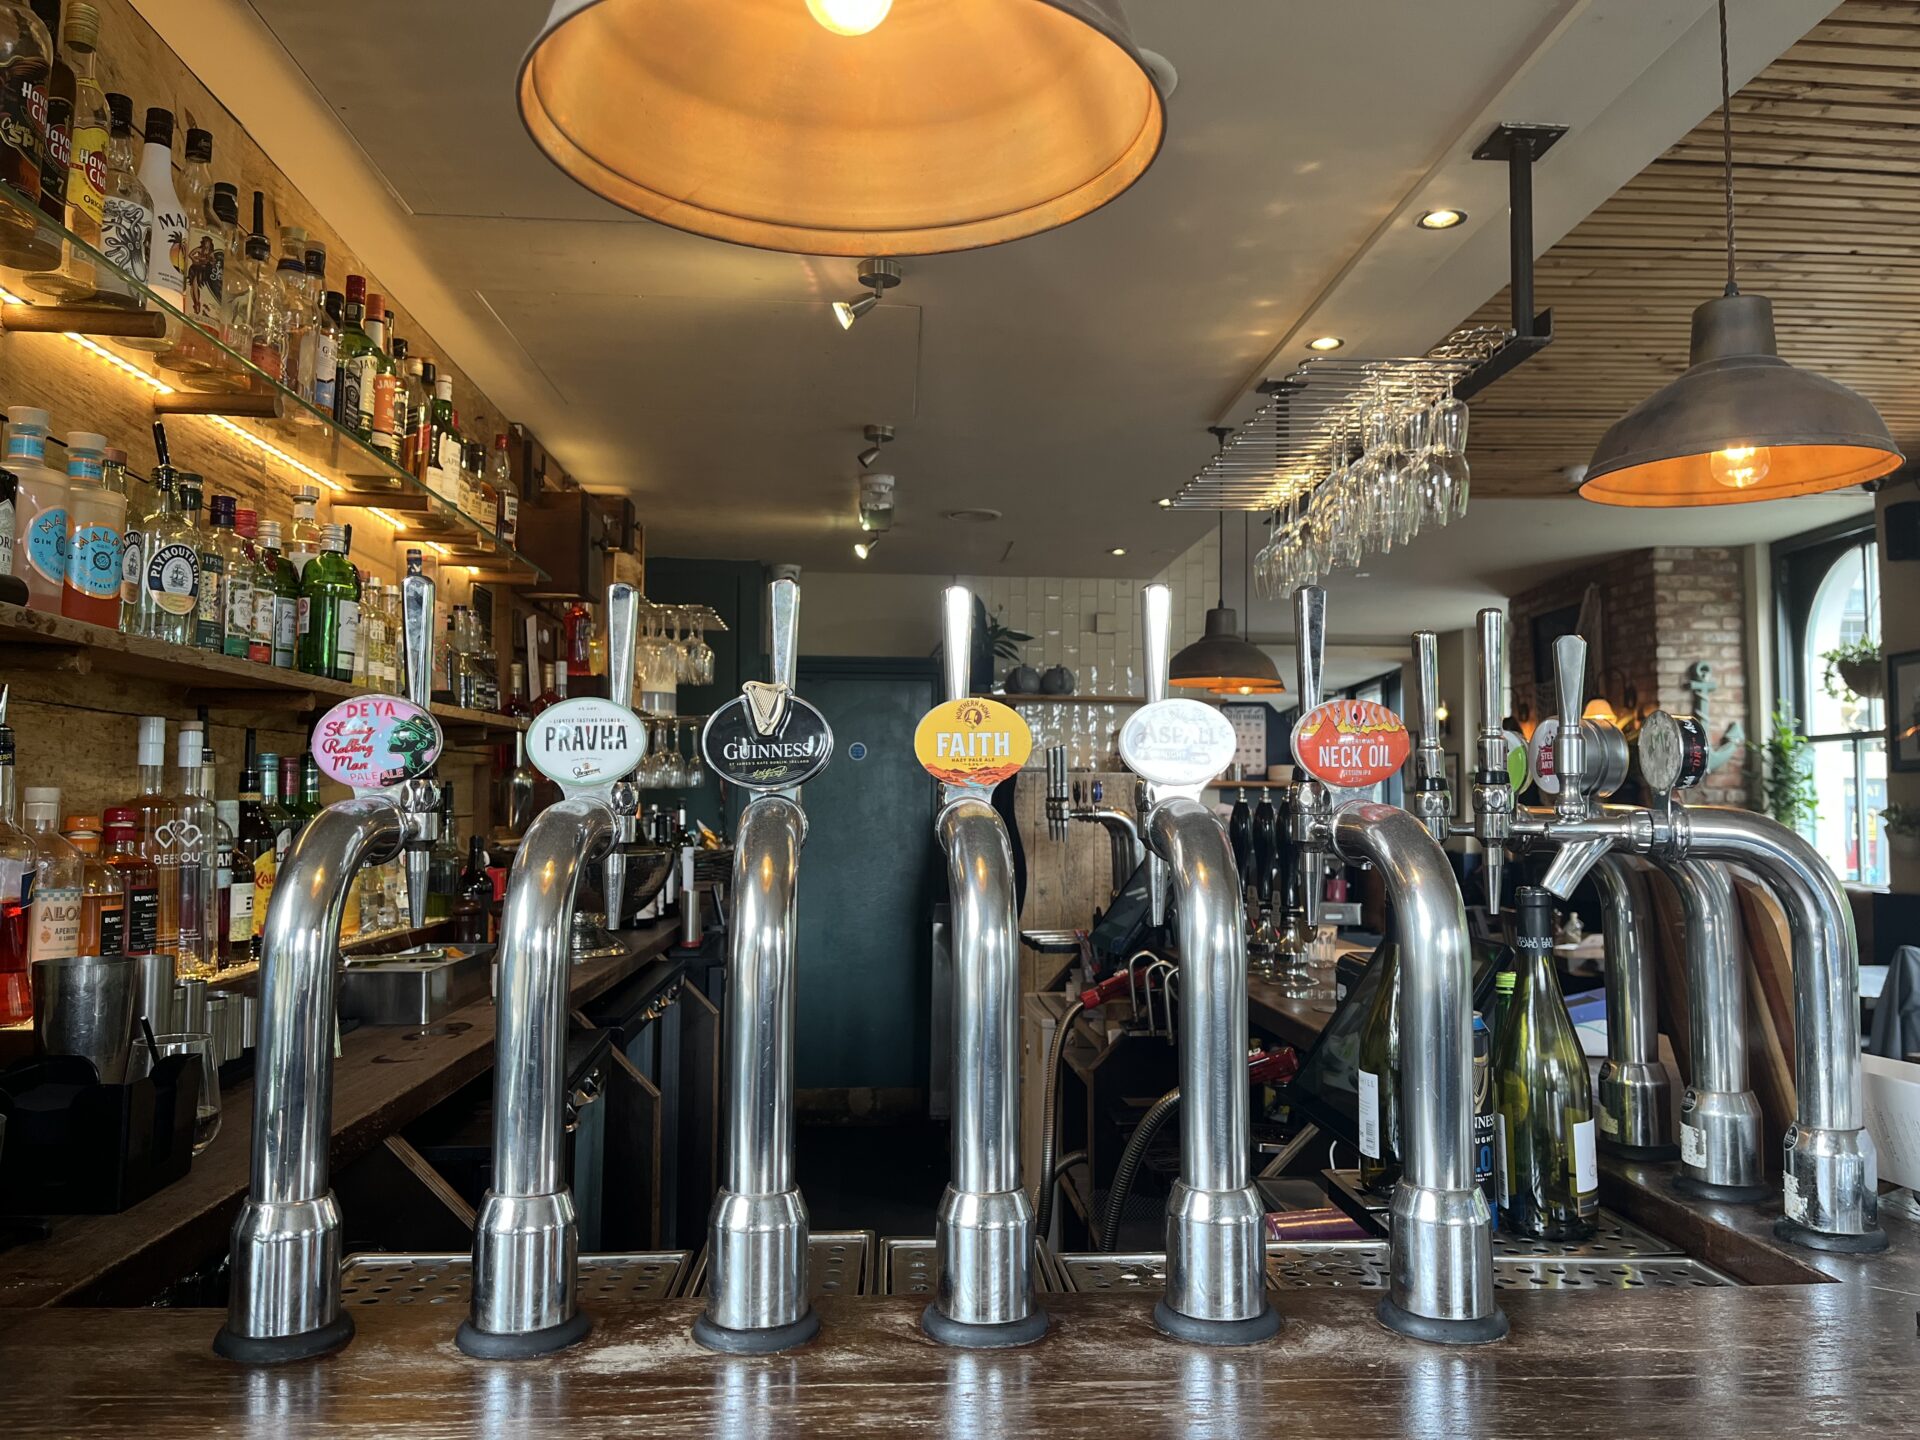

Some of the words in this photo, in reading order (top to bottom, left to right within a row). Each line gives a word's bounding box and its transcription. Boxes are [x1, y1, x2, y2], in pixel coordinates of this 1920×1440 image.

[150, 547, 195, 578] PLYMOUTH
[346, 702, 396, 719] DEYA
[955, 700, 980, 720] NORTHERN
[545, 724, 628, 752] PRAVHA
[936, 731, 1010, 758] FAITH
[322, 738, 374, 759] Rolling
[723, 741, 812, 760] GUINNESS
[1319, 745, 1363, 768] NECK
[1369, 745, 1393, 767] OIL
[332, 755, 369, 771] Man
[350, 771, 378, 780] PALE
[381, 768, 405, 780] ALE
